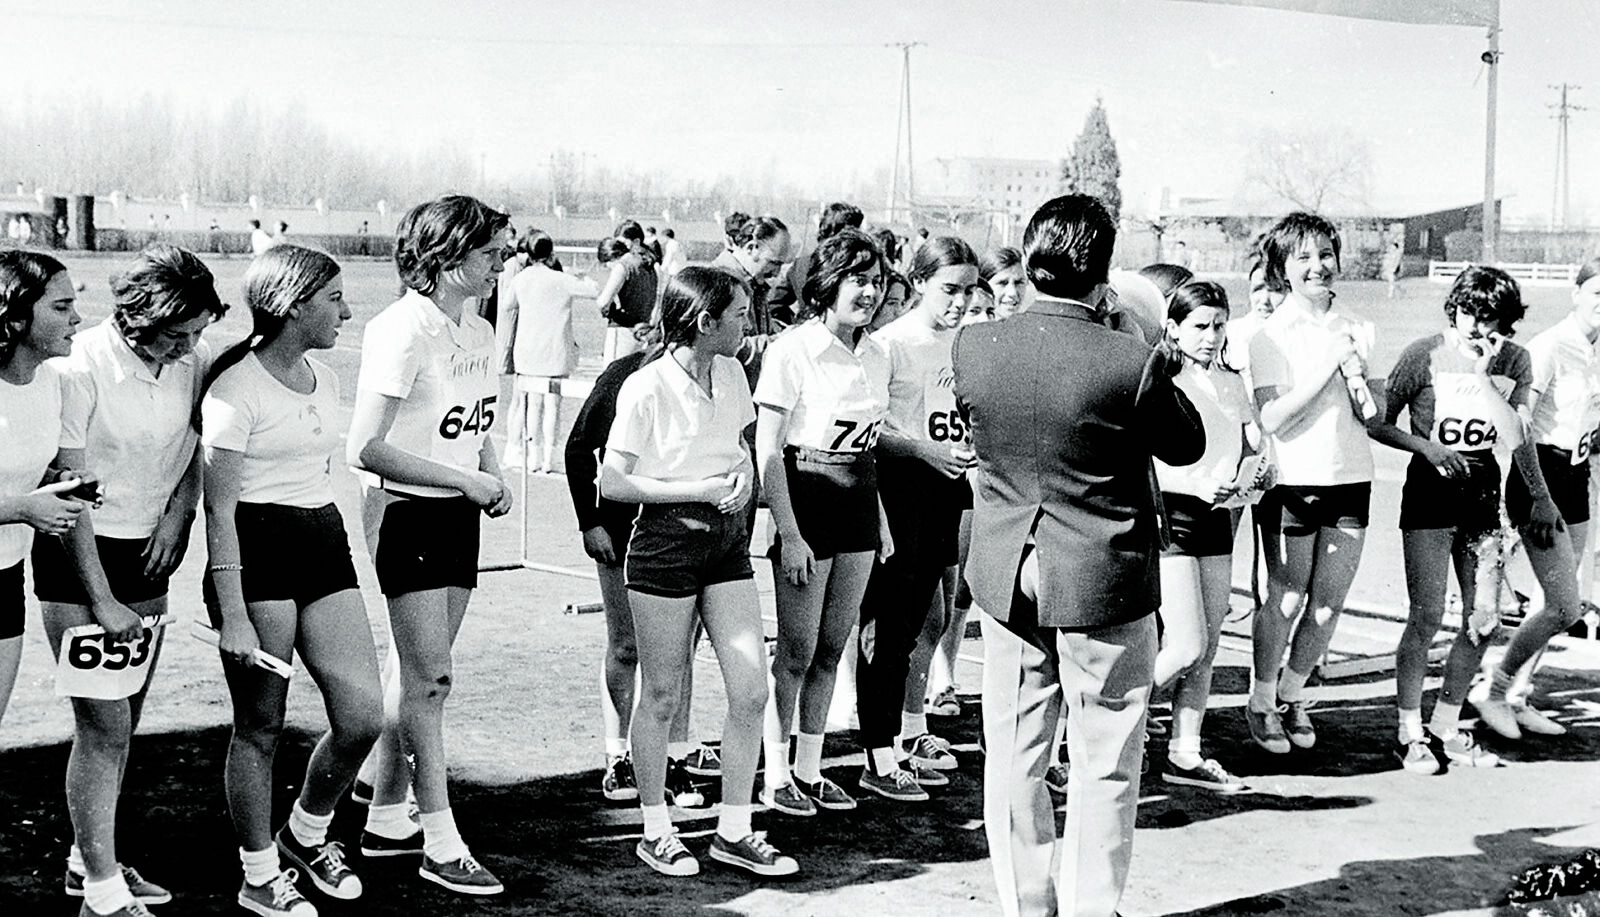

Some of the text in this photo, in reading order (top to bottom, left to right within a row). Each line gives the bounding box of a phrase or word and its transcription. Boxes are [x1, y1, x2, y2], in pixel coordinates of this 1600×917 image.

[439, 395, 497, 440] 645
[1438, 417, 1498, 446] 664
[68, 627, 153, 670] 653
